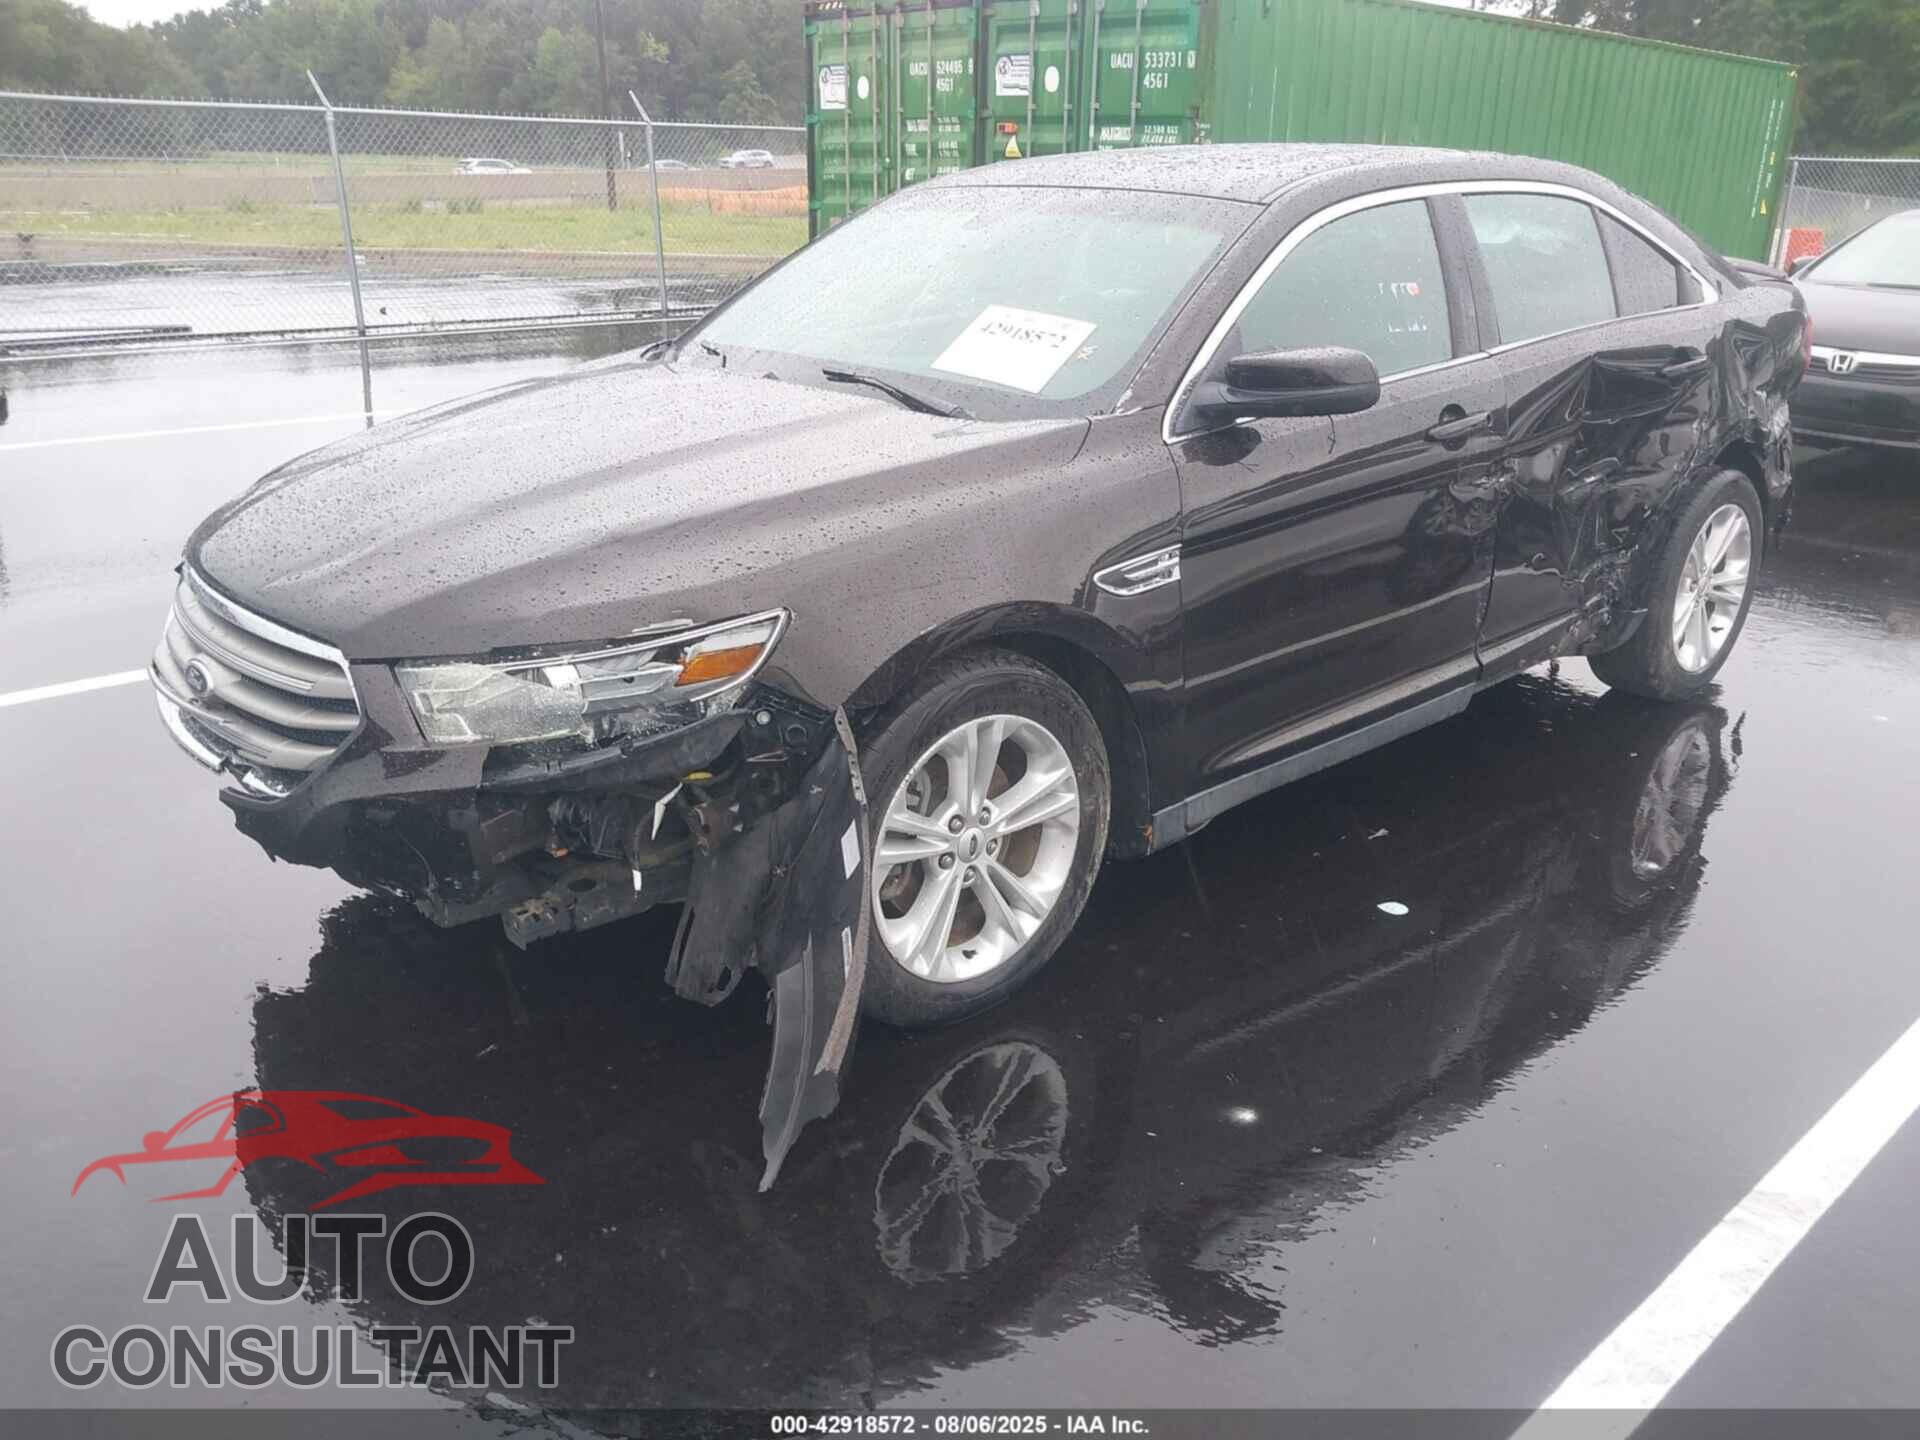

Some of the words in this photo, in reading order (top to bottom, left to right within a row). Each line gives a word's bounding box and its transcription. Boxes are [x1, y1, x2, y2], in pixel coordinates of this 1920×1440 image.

[1110, 52, 1134, 69] UACU
[1144, 50, 1182, 69] 533731
[1143, 72, 1168, 89] 45G1
